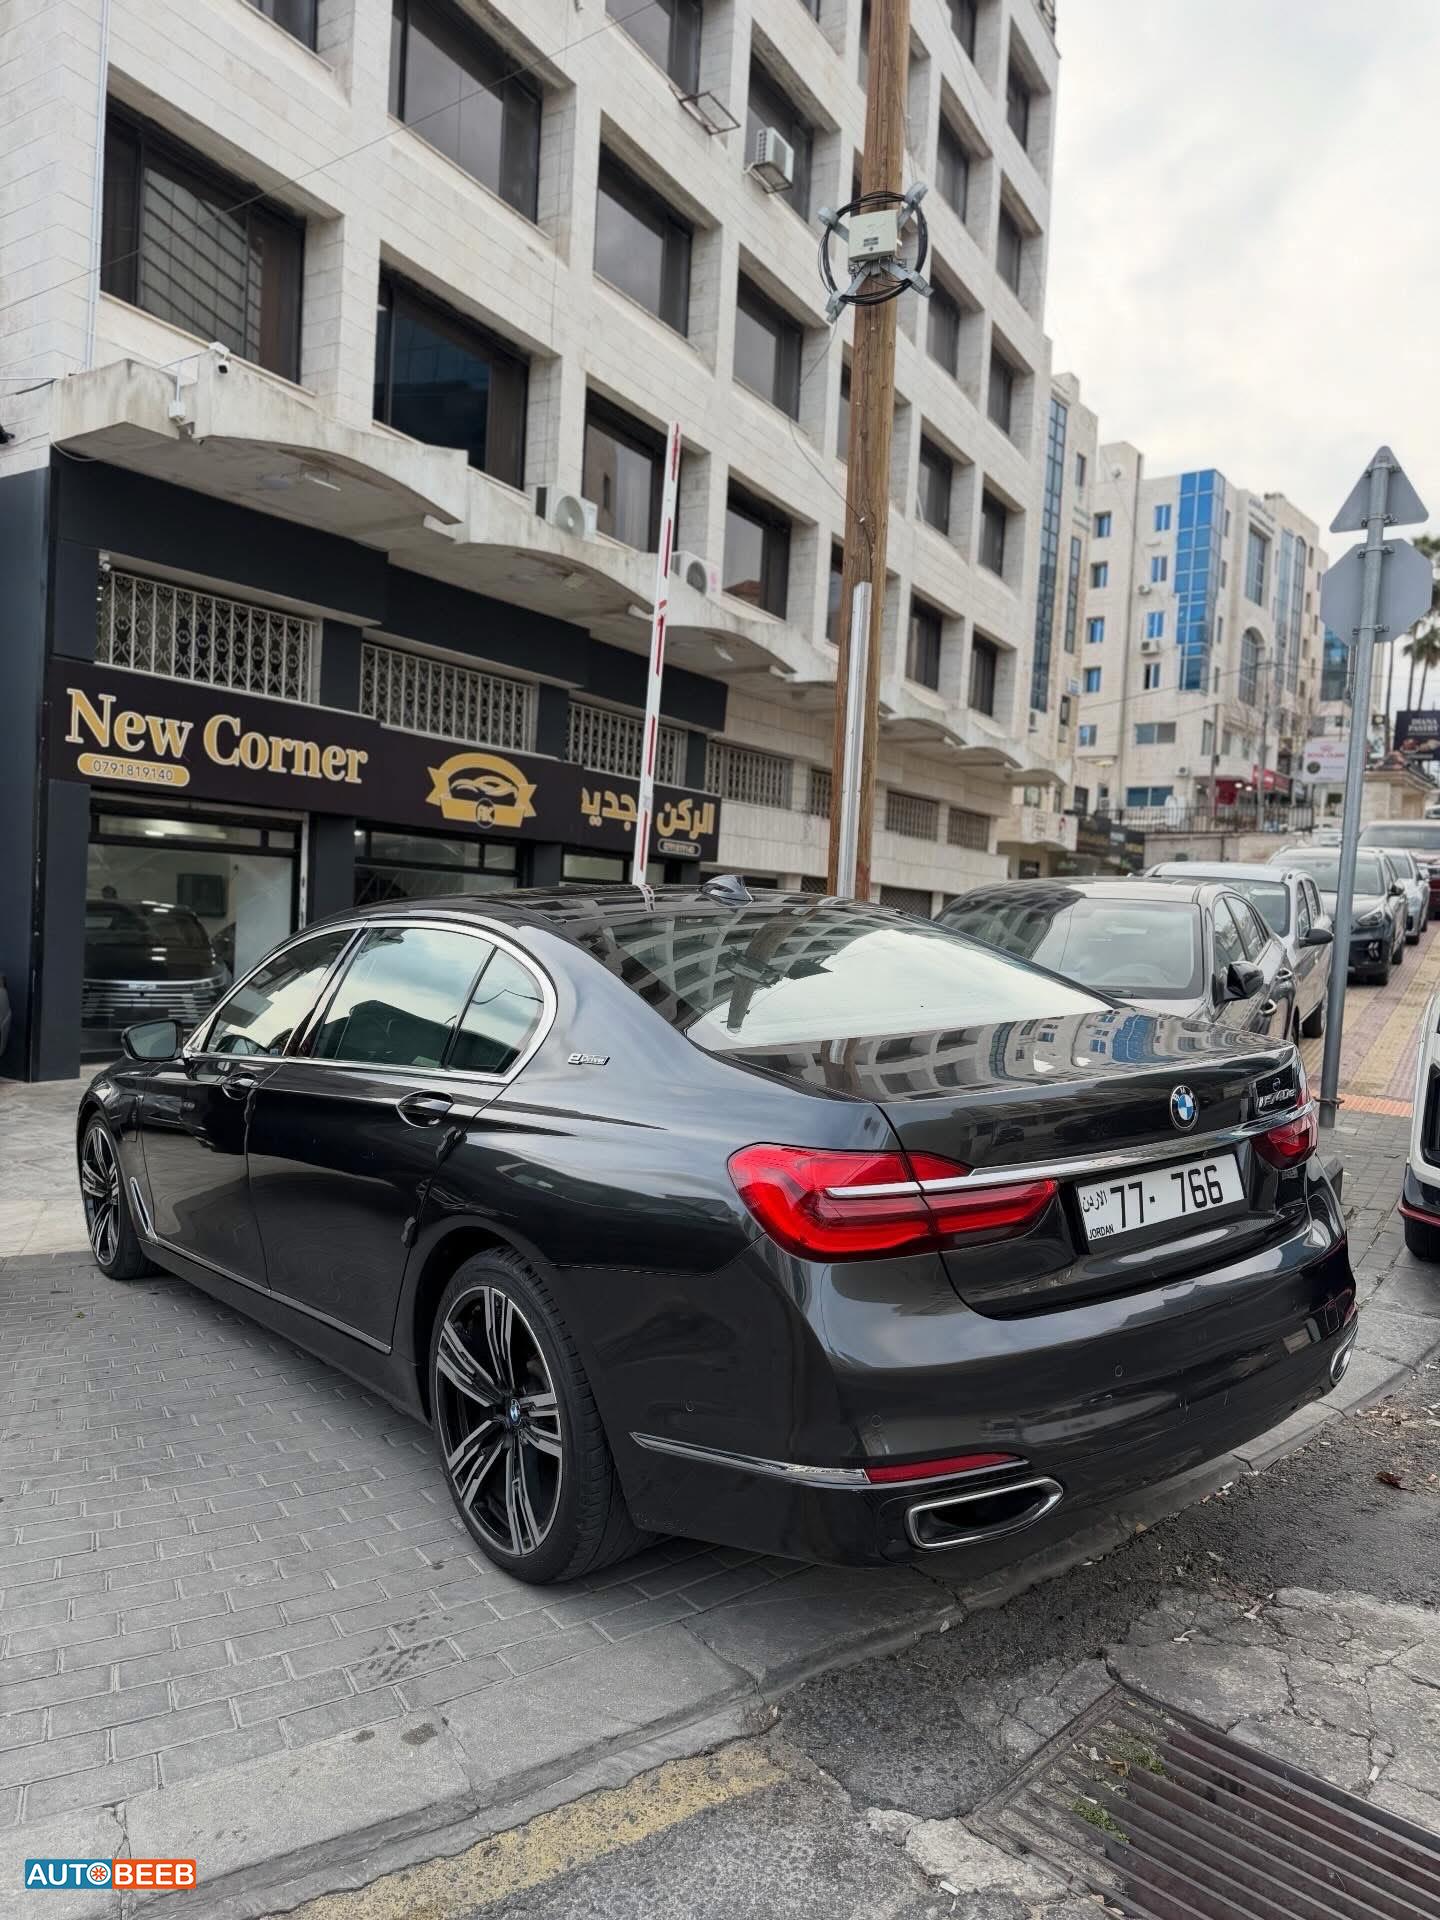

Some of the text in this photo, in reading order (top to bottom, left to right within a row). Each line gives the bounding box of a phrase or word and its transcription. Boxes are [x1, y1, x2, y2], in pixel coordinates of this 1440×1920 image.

[65, 688, 368, 784] New Corner
[93, 760, 174, 781] 0791819140
[656, 798, 715, 840] الركن
[1171, 1164, 1223, 1213] 766
[1088, 1223, 1114, 1239] JORDAN
